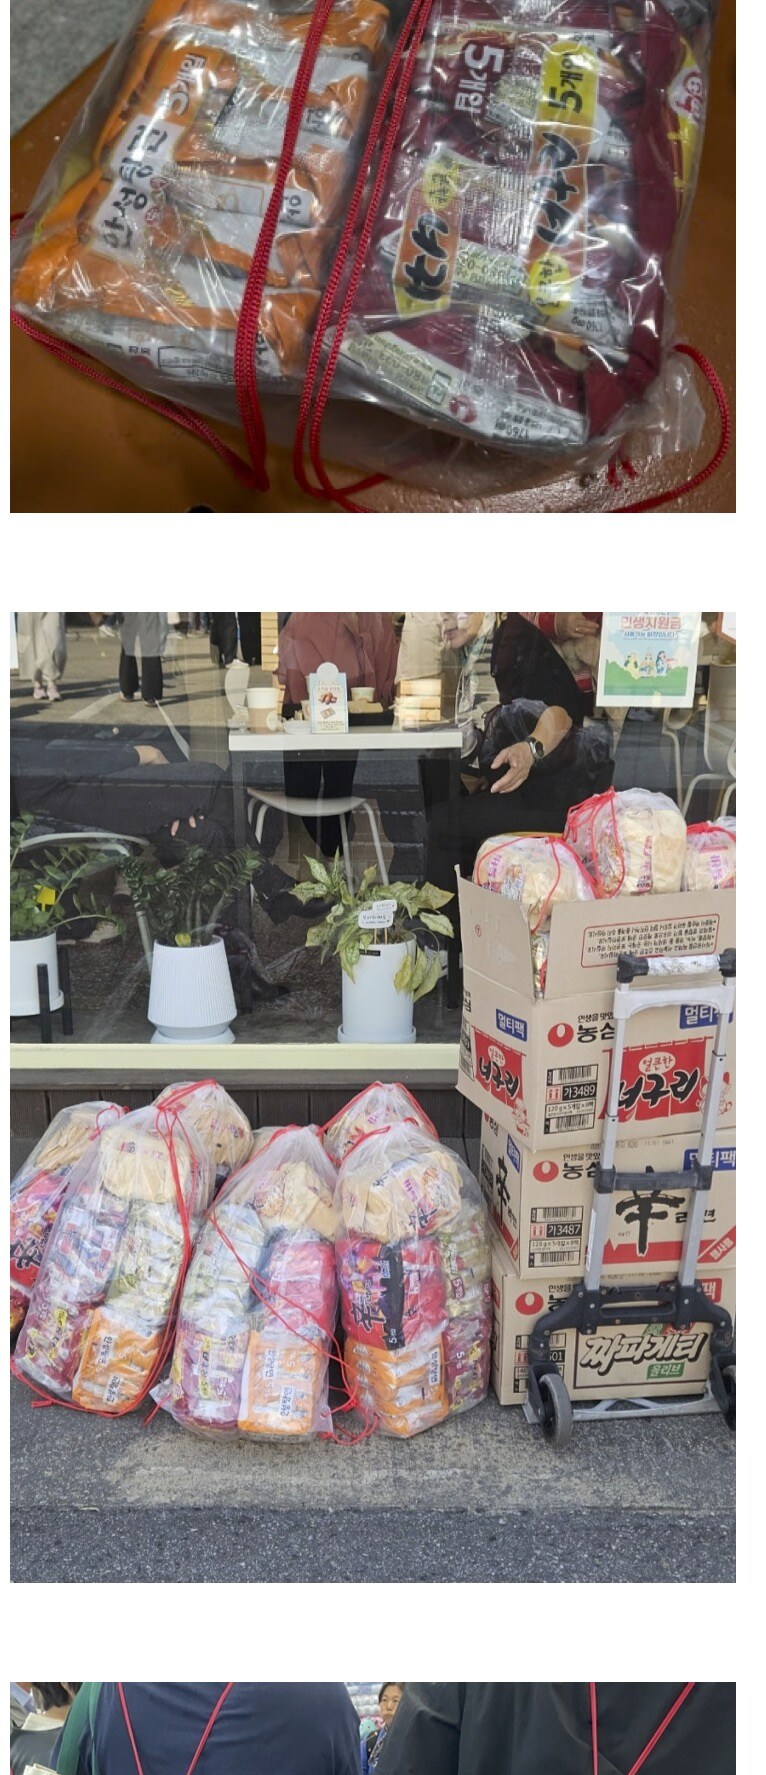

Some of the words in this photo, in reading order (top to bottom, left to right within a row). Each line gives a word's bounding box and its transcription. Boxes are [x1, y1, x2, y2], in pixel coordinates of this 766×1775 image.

[453, 43, 504, 114] 5개입
[497, 1012, 527, 1039] 멀티팩
[642, 1055, 675, 1071] 얼큰한
[478, 1056, 520, 1098] 너구리
[618, 1067, 701, 1109] 너구리
[563, 1084, 596, 1100] 가3489
[548, 1225, 580, 1237] 가3487
[580, 1332, 705, 1375] 짜파게티
[649, 1363, 683, 1377] 올리브
